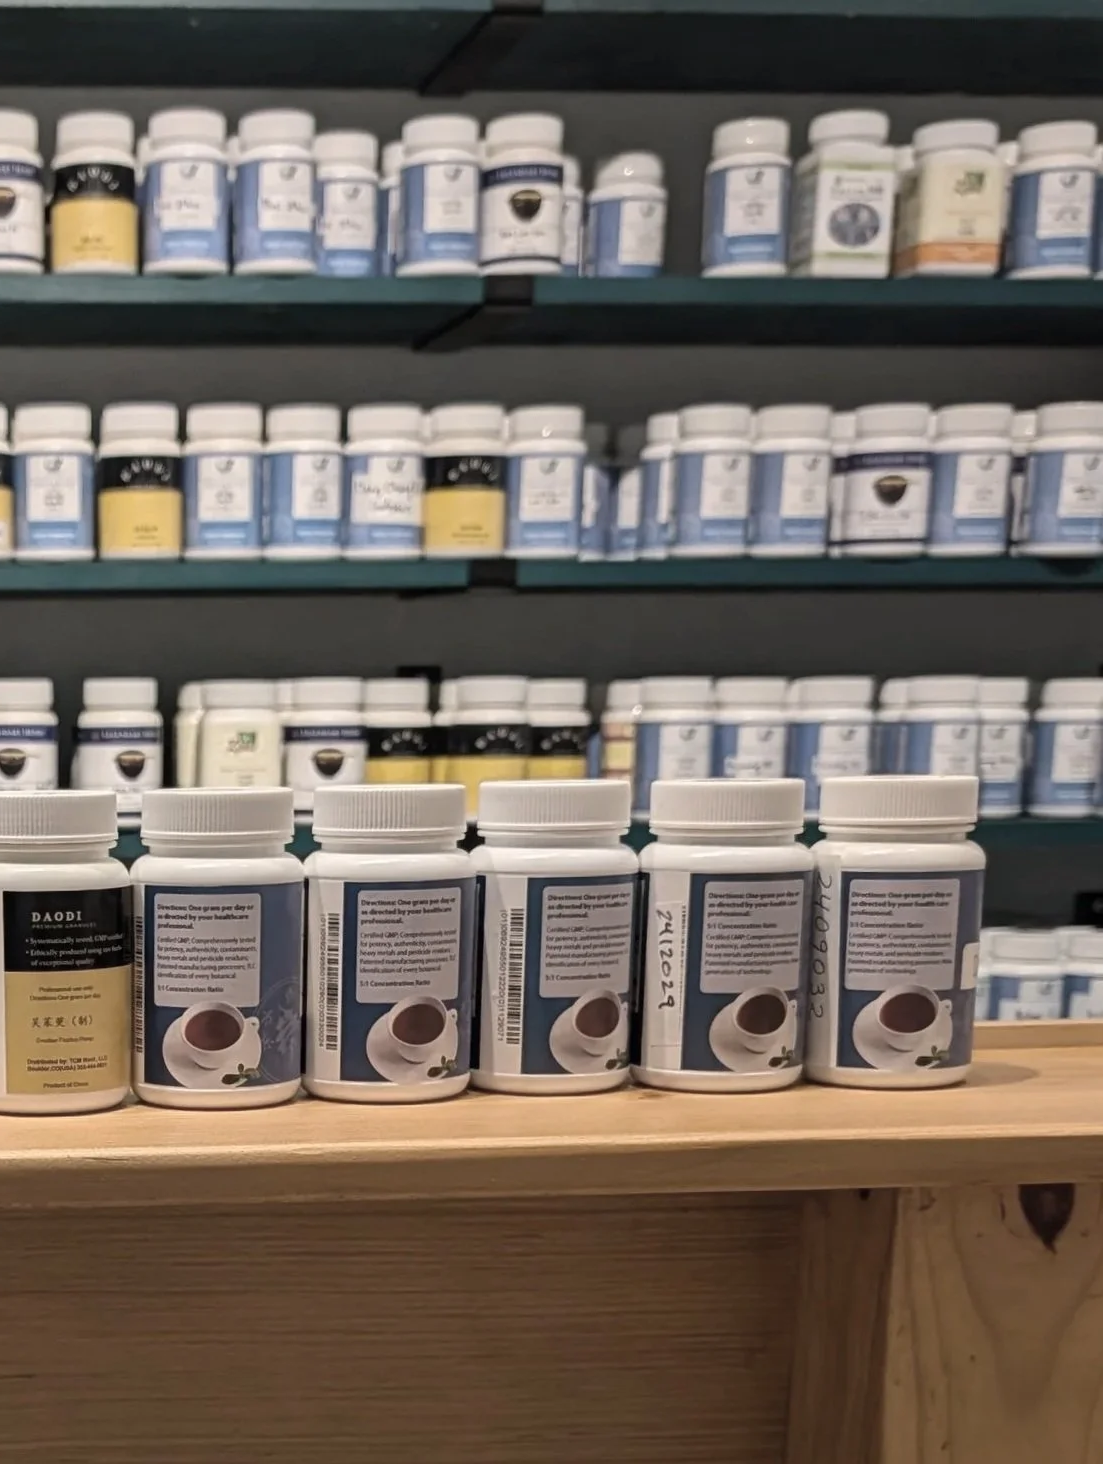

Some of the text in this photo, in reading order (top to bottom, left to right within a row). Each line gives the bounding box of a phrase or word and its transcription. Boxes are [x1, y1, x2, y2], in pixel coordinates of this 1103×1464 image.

[221, 904, 232, 912] per
[234, 904, 246, 912] day
[369, 908, 397, 916] directed
[397, 908, 406, 916] by
[31, 911, 82, 922] DAODI
[189, 914, 197, 922] by
[368, 940, 393, 949] potency,
[810, 875, 832, 1018] 2409032
[656, 909, 675, 1010] 2412029
[370, 979, 415, 987] Concentration
